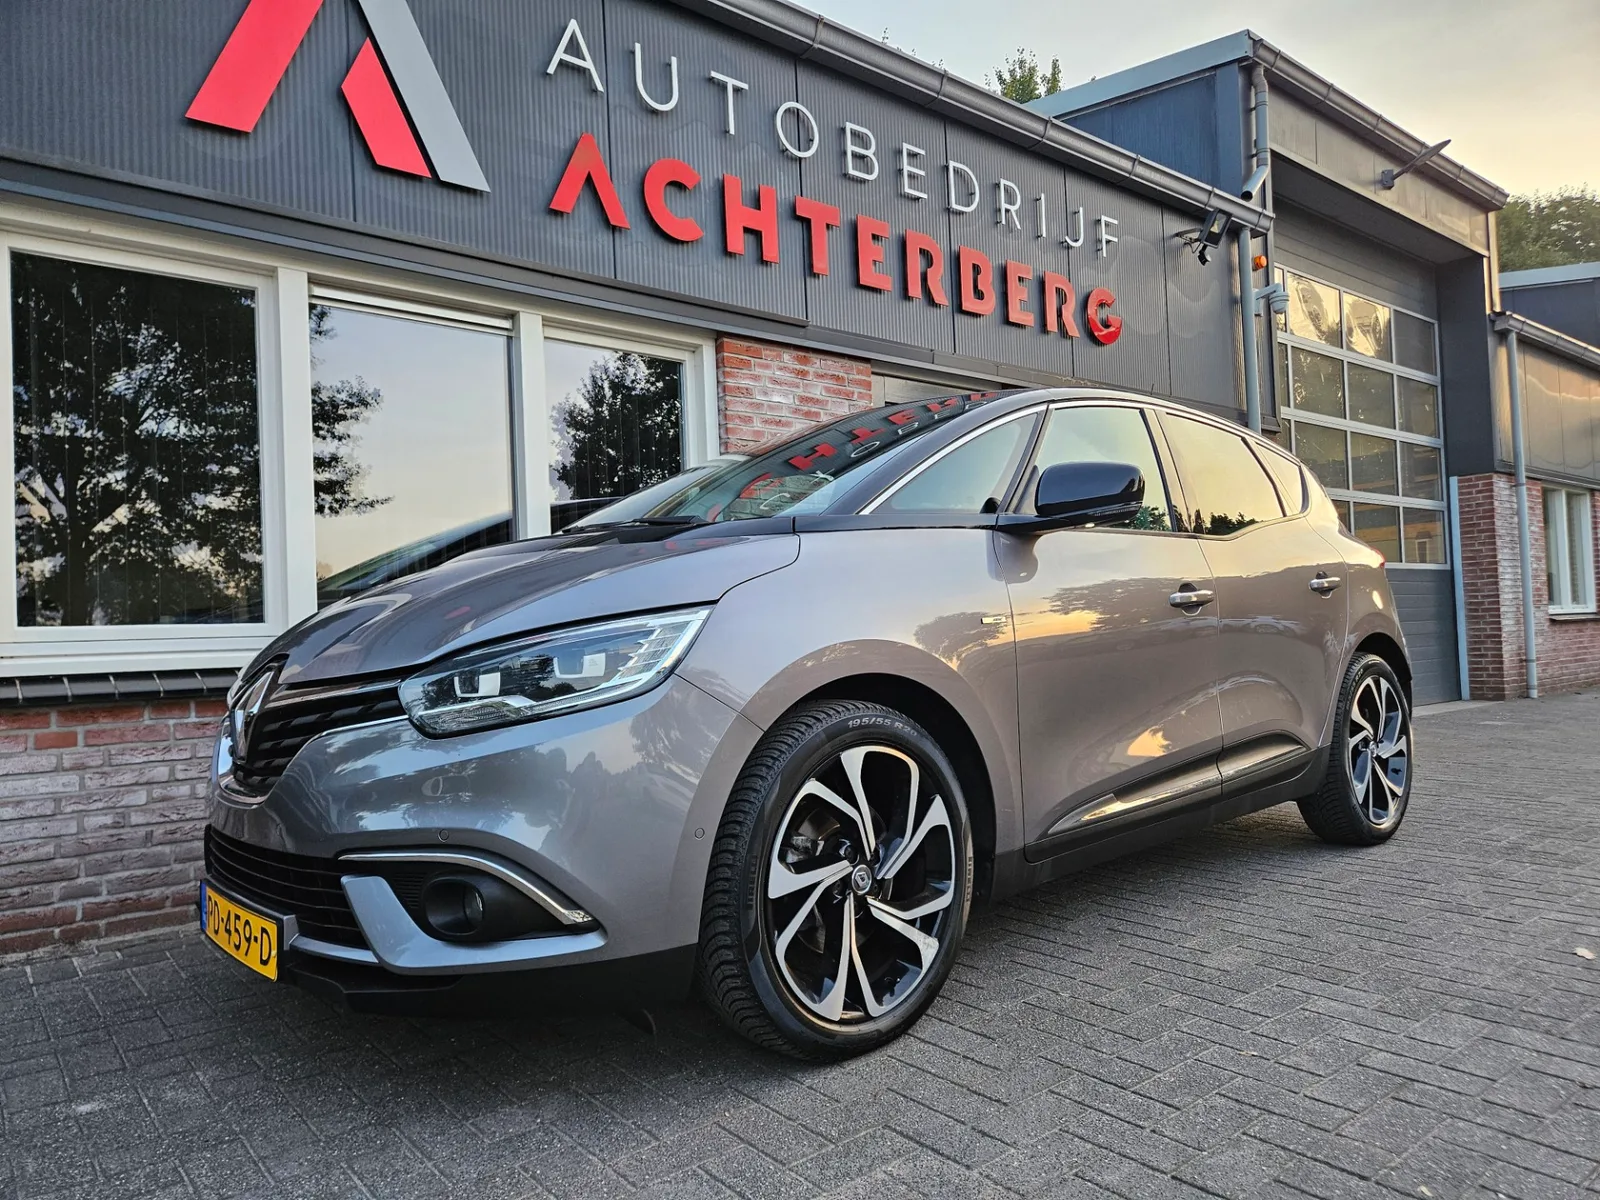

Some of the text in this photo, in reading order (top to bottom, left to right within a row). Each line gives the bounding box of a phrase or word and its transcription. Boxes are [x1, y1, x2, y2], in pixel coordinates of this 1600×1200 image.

[546, 19, 1119, 258] AUTOBEDRIJF
[549, 132, 1123, 345] ACHTERBERG
[847, 717, 918, 736] 195/55 R20
[207, 894, 272, 967] PD-459-D
